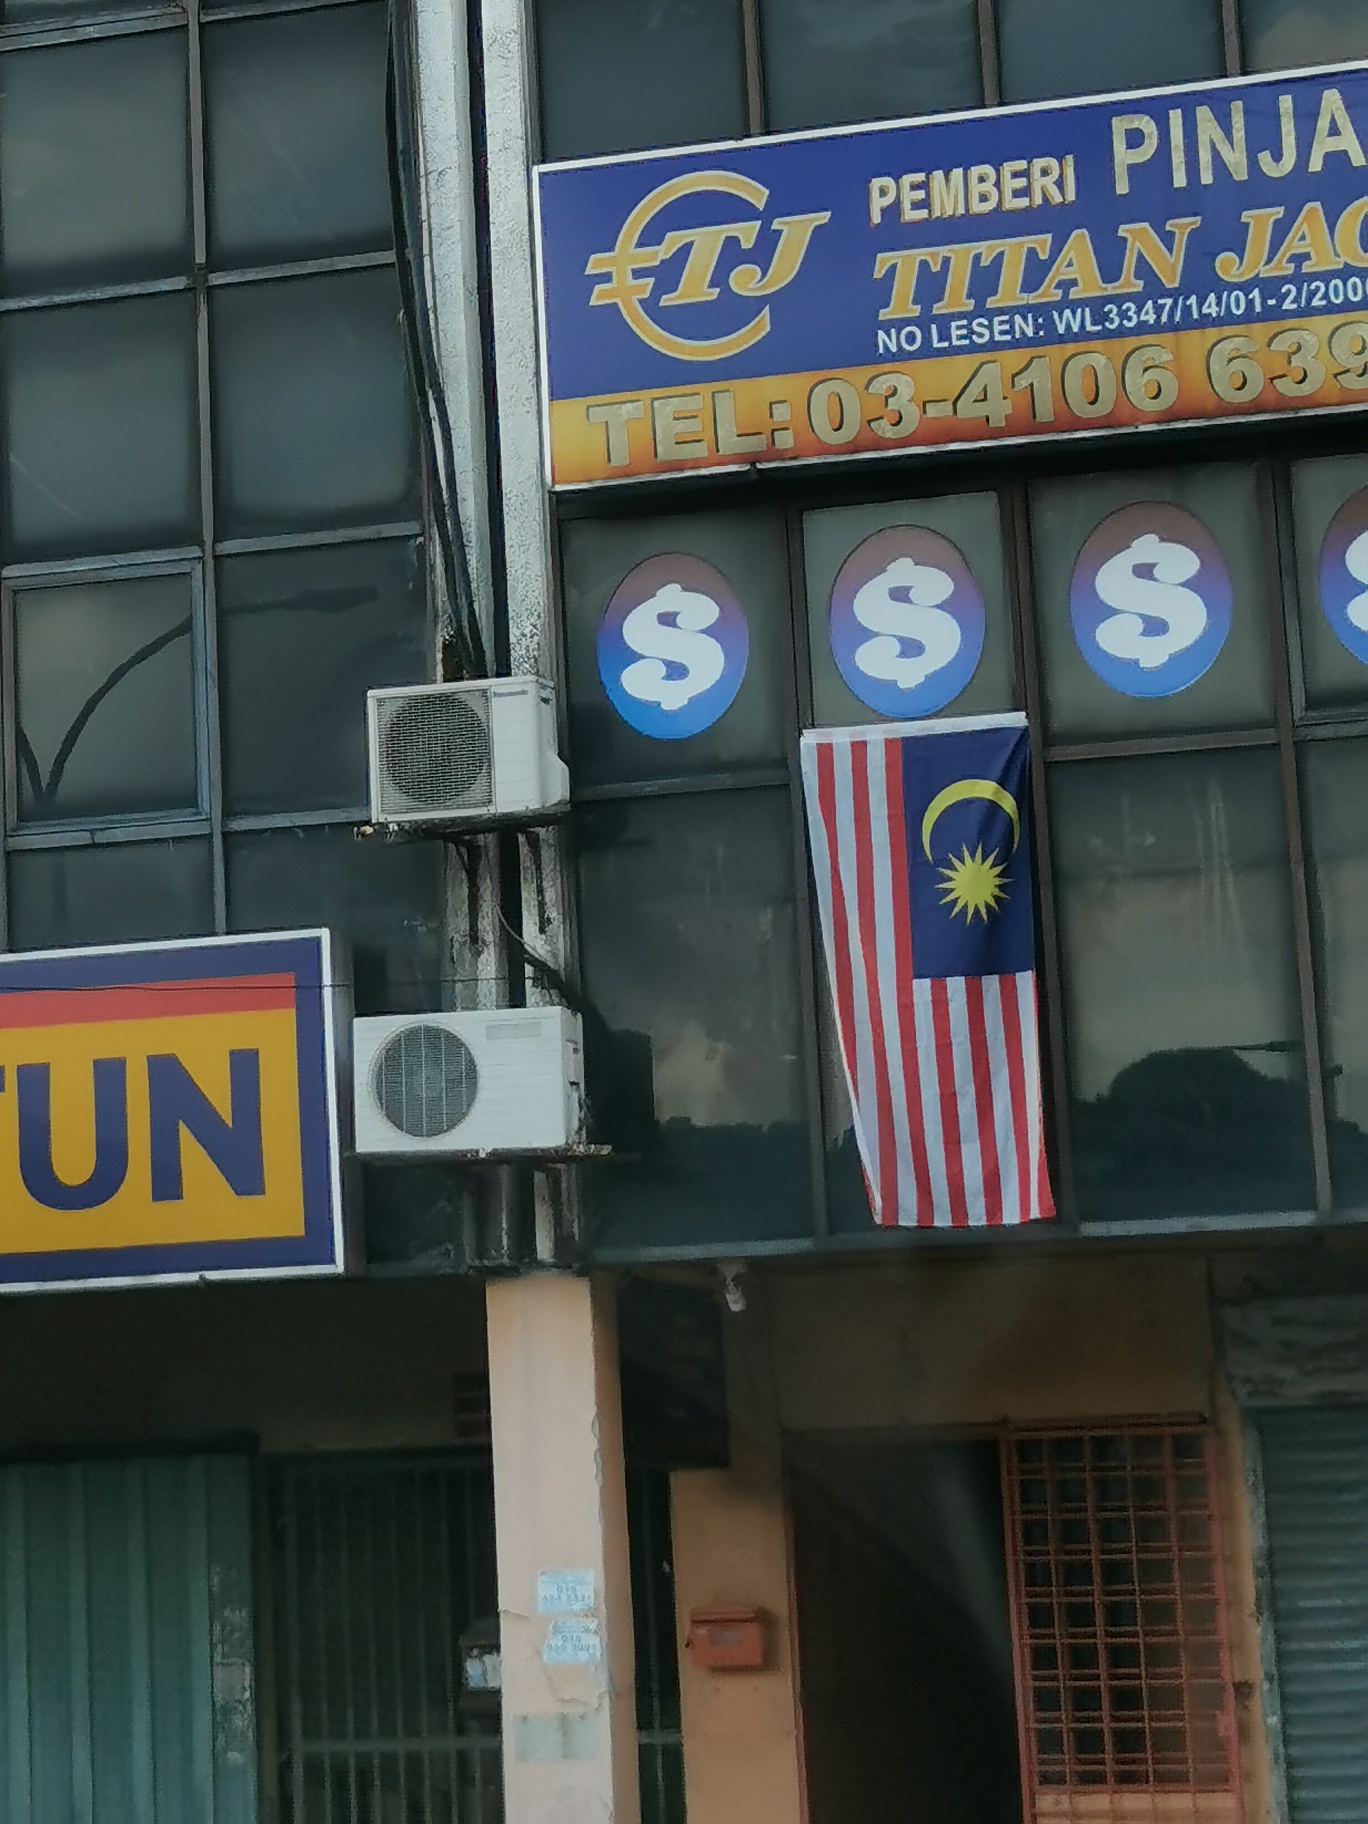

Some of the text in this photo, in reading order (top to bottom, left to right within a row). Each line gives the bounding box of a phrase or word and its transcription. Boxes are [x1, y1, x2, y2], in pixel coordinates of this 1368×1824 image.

[868, 87, 1368, 226] PEMBERI PINJA
[873, 216, 1202, 321] TITAN
[877, 324, 923, 354] NO
[930, 312, 1046, 349] LESEN:
